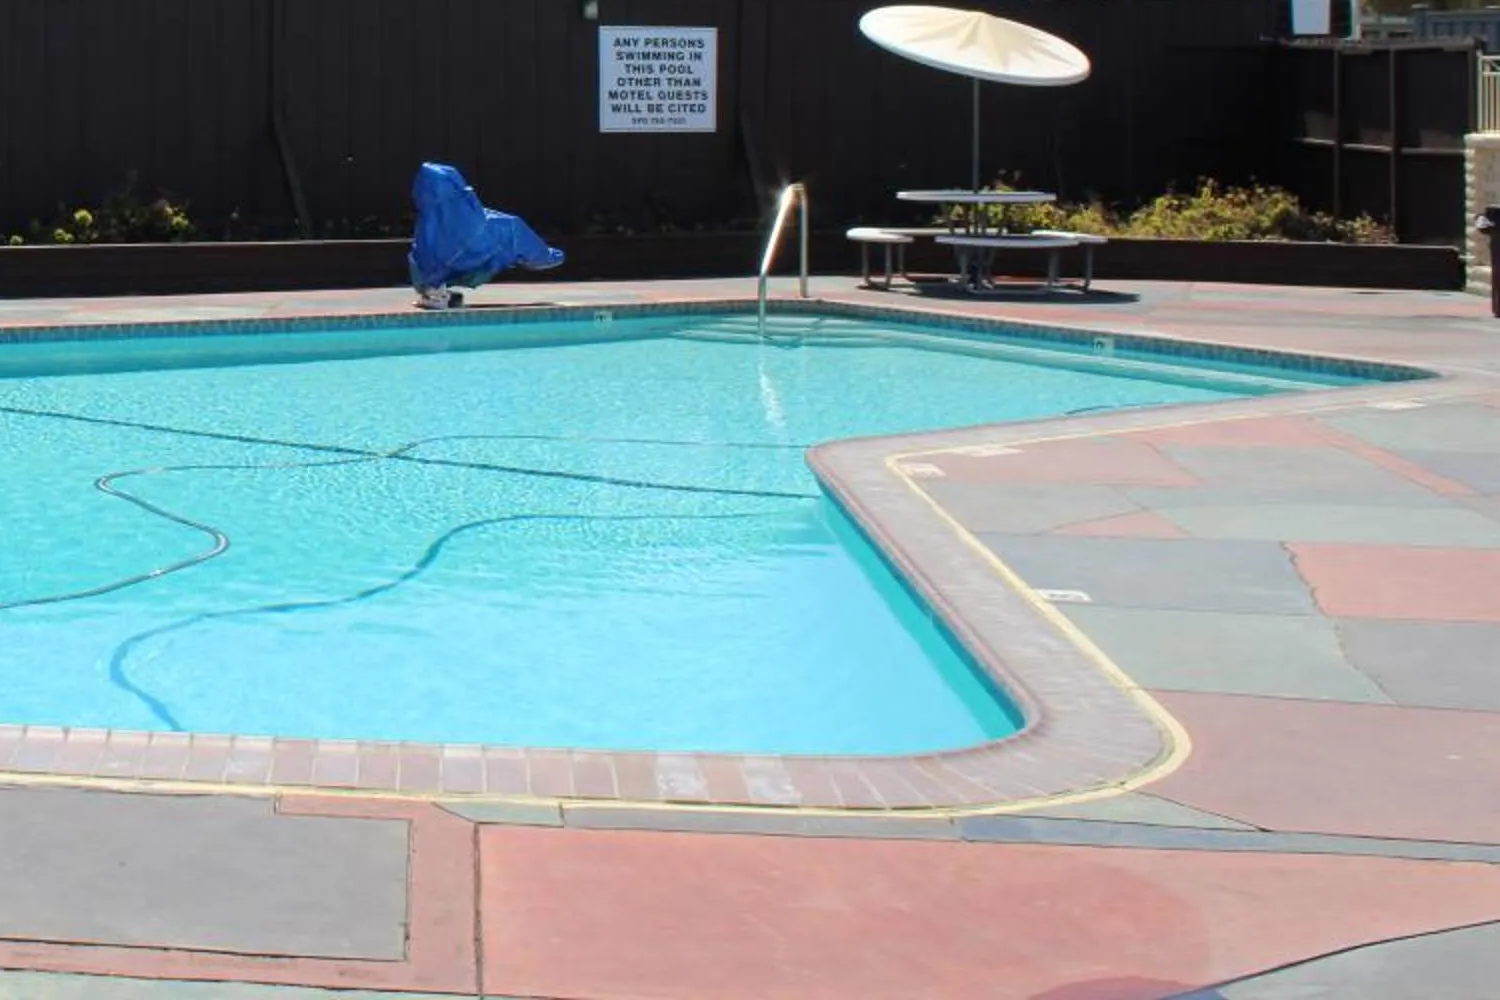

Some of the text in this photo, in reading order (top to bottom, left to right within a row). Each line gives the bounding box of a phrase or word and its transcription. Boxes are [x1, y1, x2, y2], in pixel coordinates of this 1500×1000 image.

[614, 38, 705, 48] ANY PERSONS
[616, 52, 702, 60] SWIMMING IN
[625, 64, 693, 74] THIS POOL
[617, 78, 701, 87] OTHER THAN
[608, 90, 653, 100] MOTEL
[611, 104, 706, 113] WILL BE CITED
